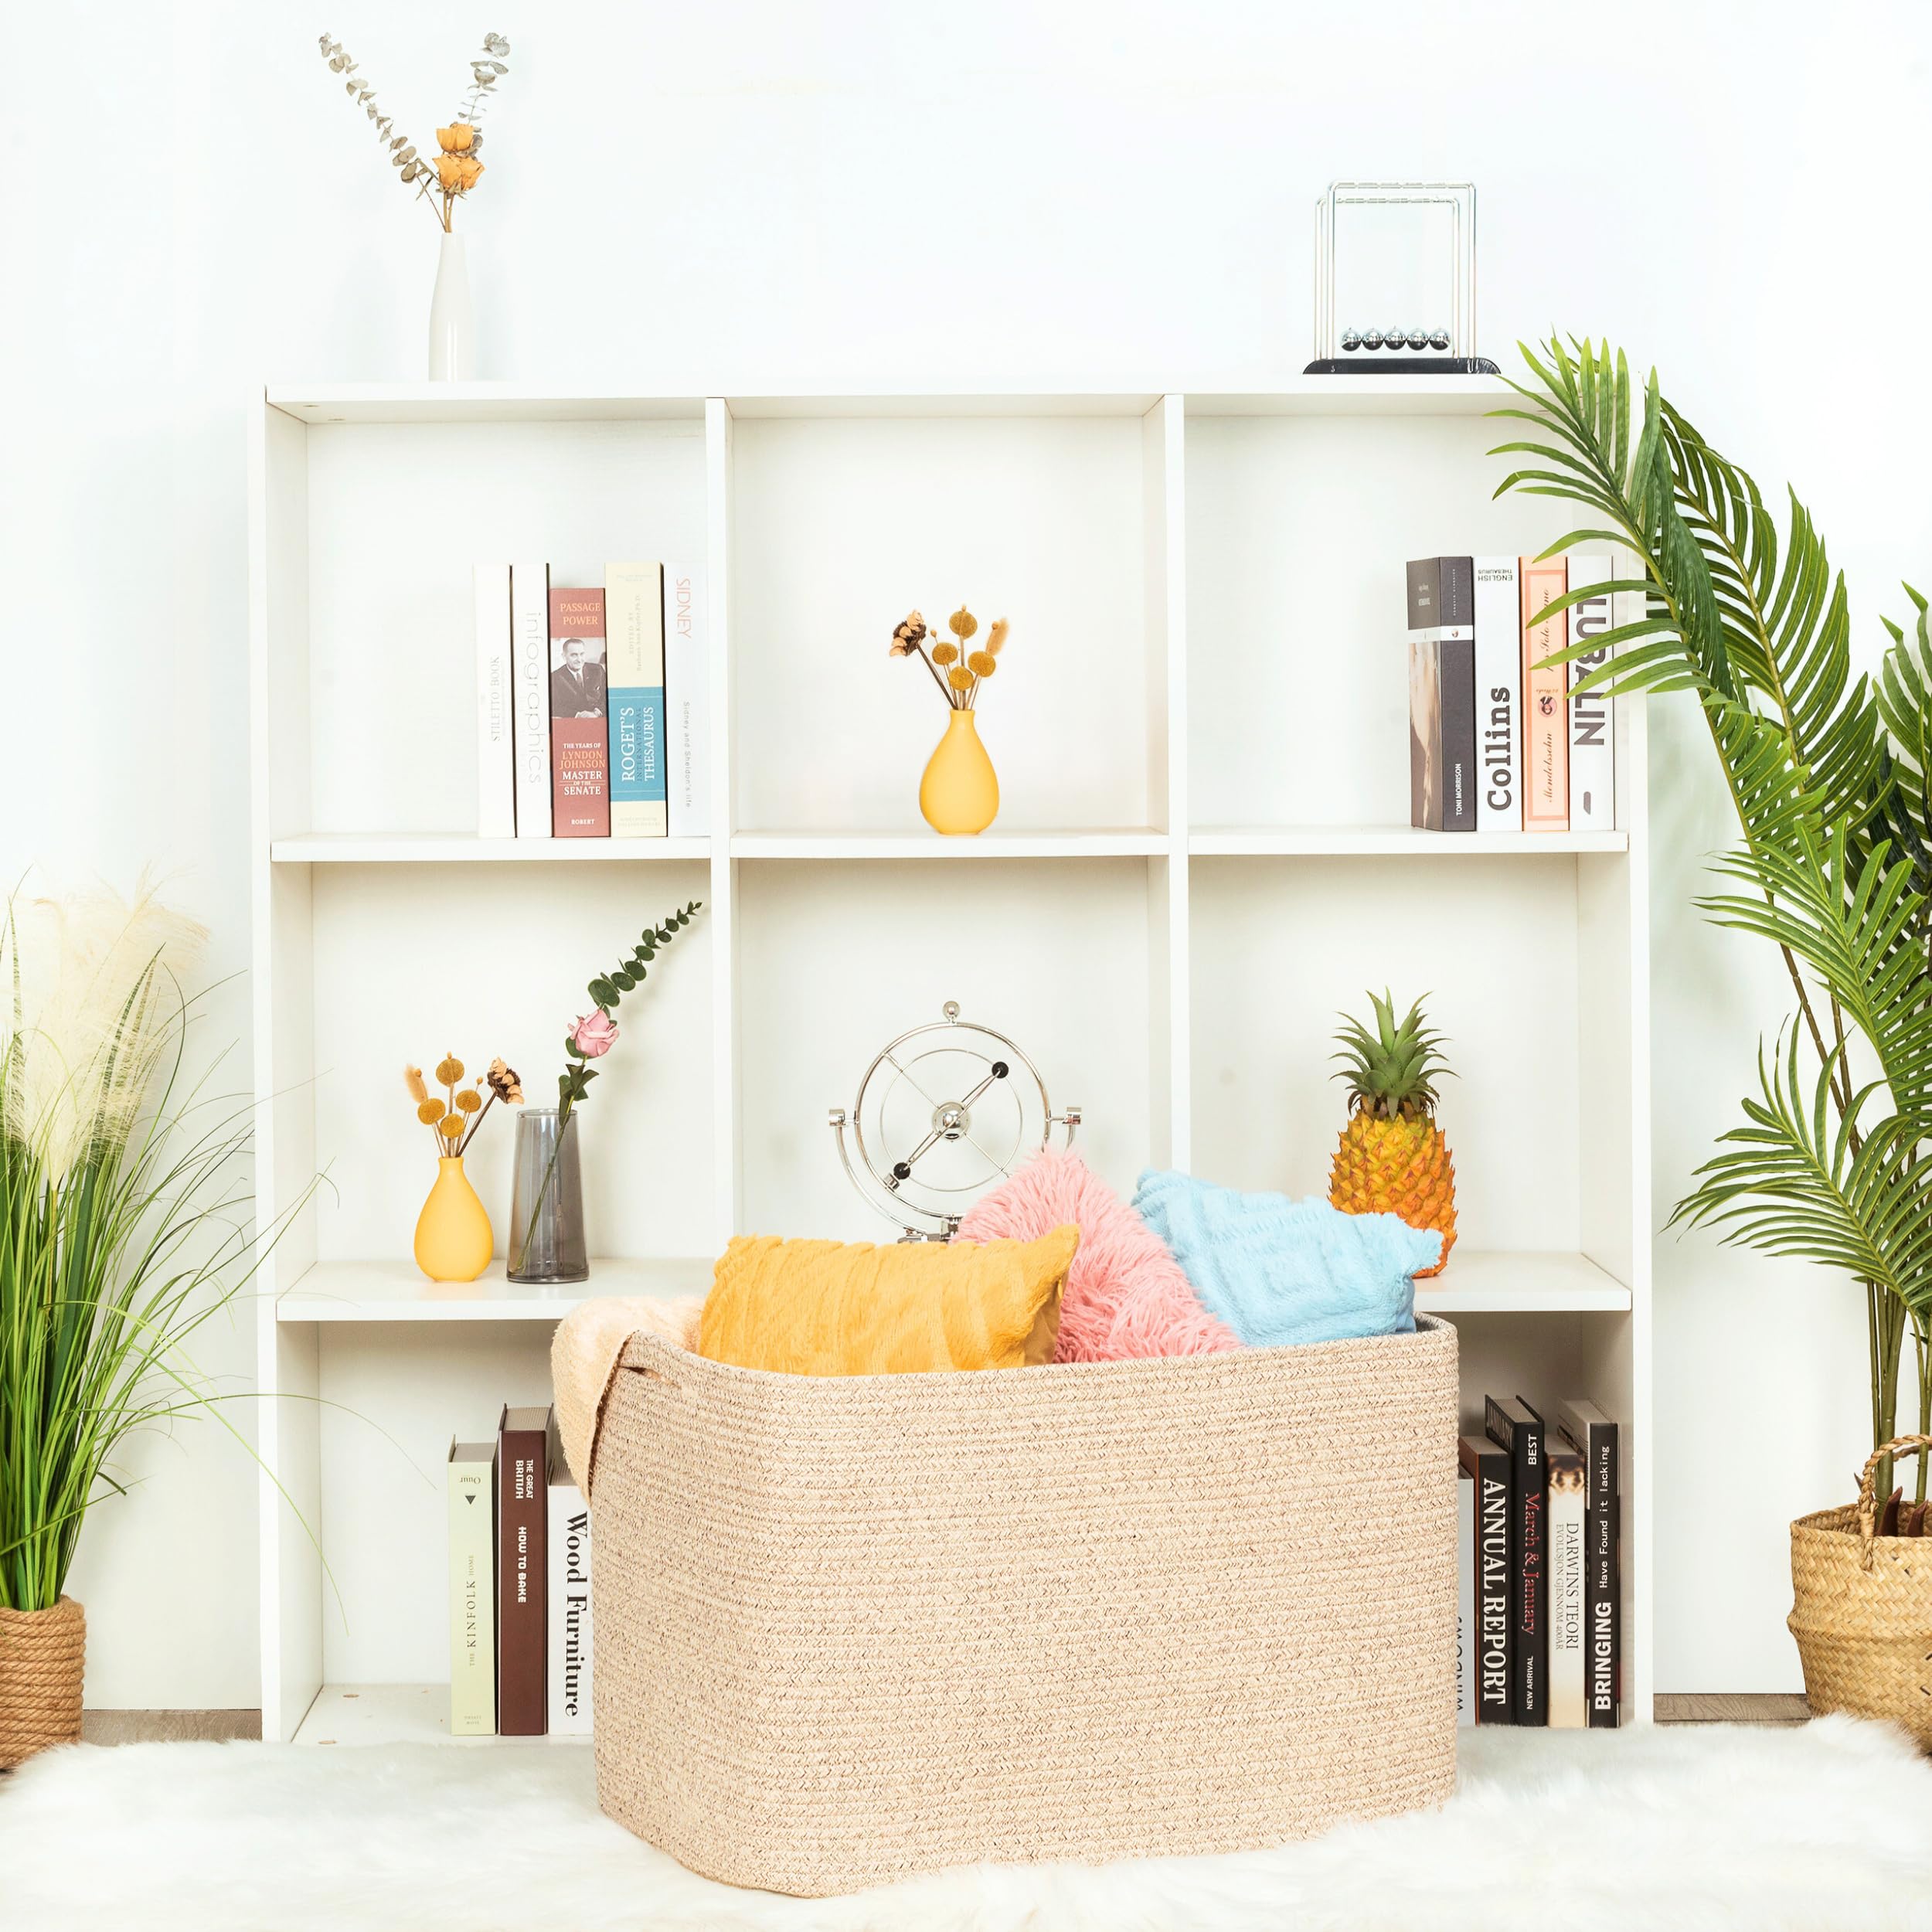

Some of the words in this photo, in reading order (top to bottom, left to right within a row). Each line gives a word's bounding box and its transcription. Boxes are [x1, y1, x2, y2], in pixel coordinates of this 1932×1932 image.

[560, 603, 601, 613] PASSAGE
[563, 616, 598, 626] POWER
[676, 578, 692, 638] SIDNEY
[490, 657, 499, 686] BOOK
[491, 692, 500, 741] STILETTO
[526, 612, 544, 783] infographics
[559, 759, 606, 770] JOHNSON
[562, 750, 603, 760] LYNDON
[620, 706, 636, 782] ROGET'S
[643, 707, 655, 781] THESAURUS
[1485, 687, 1512, 810] Collins
[563, 771, 602, 780] MASTER
[564, 785, 600, 795] SENATE
[1528, 1434, 1537, 1465] BEST
[1600, 1447, 1609, 1492] lacking
[515, 1461, 524, 1498] BRITISH
[1526, 1493, 1539, 1546] March
[1600, 1501, 1607, 1512] it
[567, 1512, 587, 1583] Wood
[1484, 1478, 1505, 1588] ANNUAL
[1554, 1524, 1564, 1575] EVOLUSJON
[519, 1556, 526, 1569] TO
[1525, 1552, 1539, 1566] &
[1566, 1523, 1578, 1597] DARWINS
[518, 1573, 526, 1602] BAKE
[1522, 1569, 1539, 1634] January
[1554, 1578, 1563, 1622] GJENNOM
[466, 1580, 477, 1648] KINFOLK
[1566, 1602, 1578, 1648] TEORI
[566, 1595, 587, 1716] Furniture
[1484, 1595, 1505, 1704] REPORT
[1595, 1603, 1611, 1709] BRINGING
